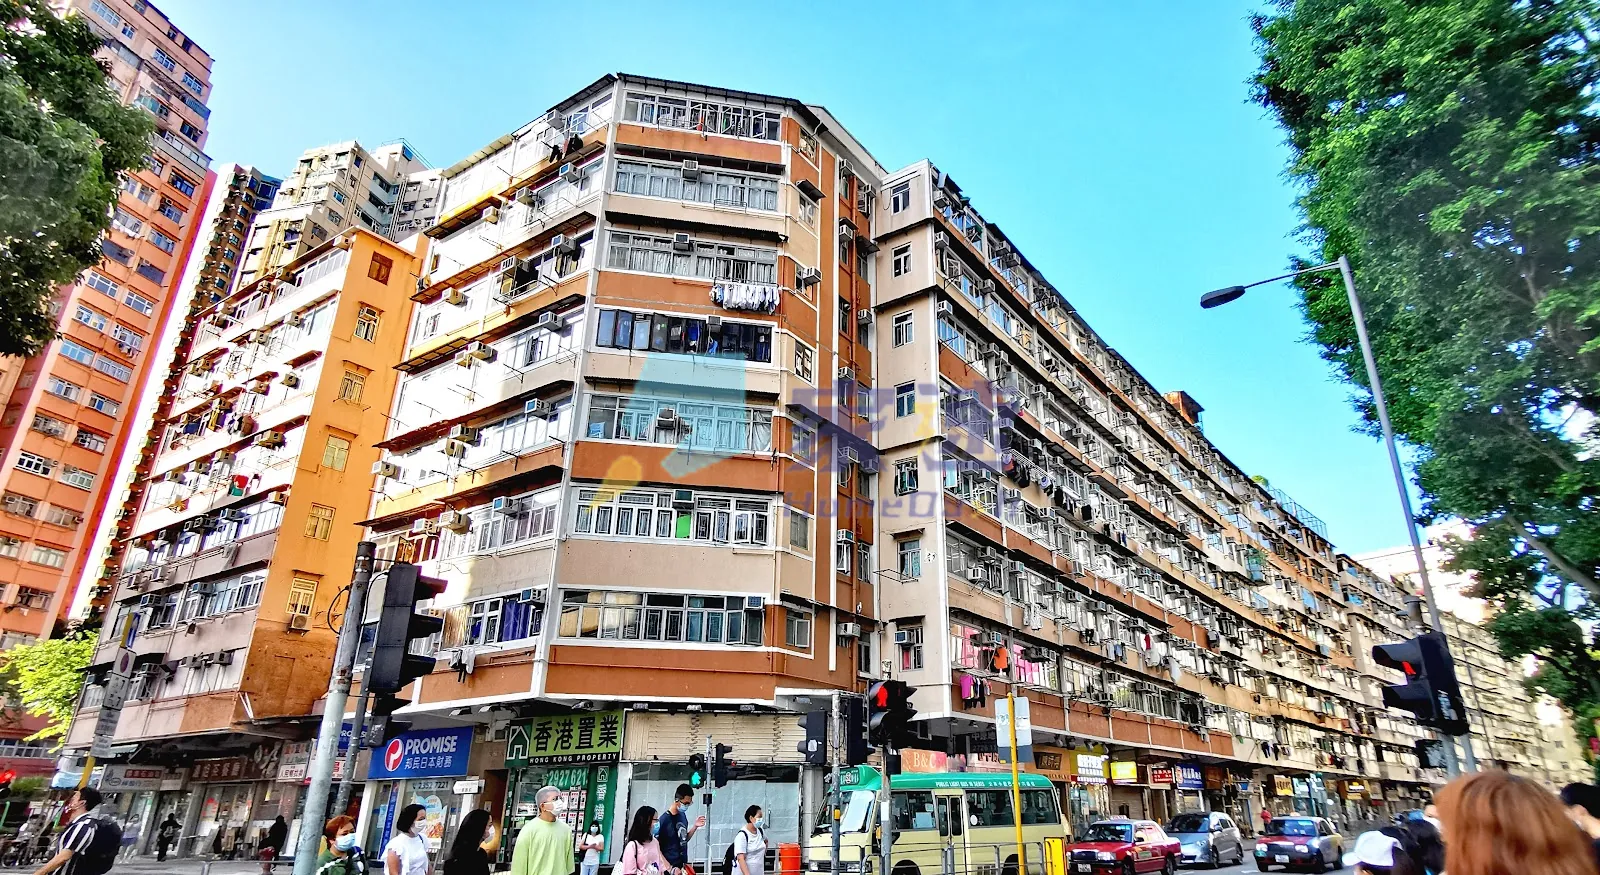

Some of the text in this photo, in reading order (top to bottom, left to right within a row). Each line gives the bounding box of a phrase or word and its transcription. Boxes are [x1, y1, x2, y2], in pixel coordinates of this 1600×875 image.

[533, 714, 619, 752] 香港置業
[405, 735, 458, 755] PROMISE
[404, 755, 453, 770] 邦民日本財務
[529, 753, 617, 764] HONG KONG PROPERTY
[434, 780, 449, 789] 7221
[548, 769, 570, 787] 2927
[570, 768, 589, 786] 621
